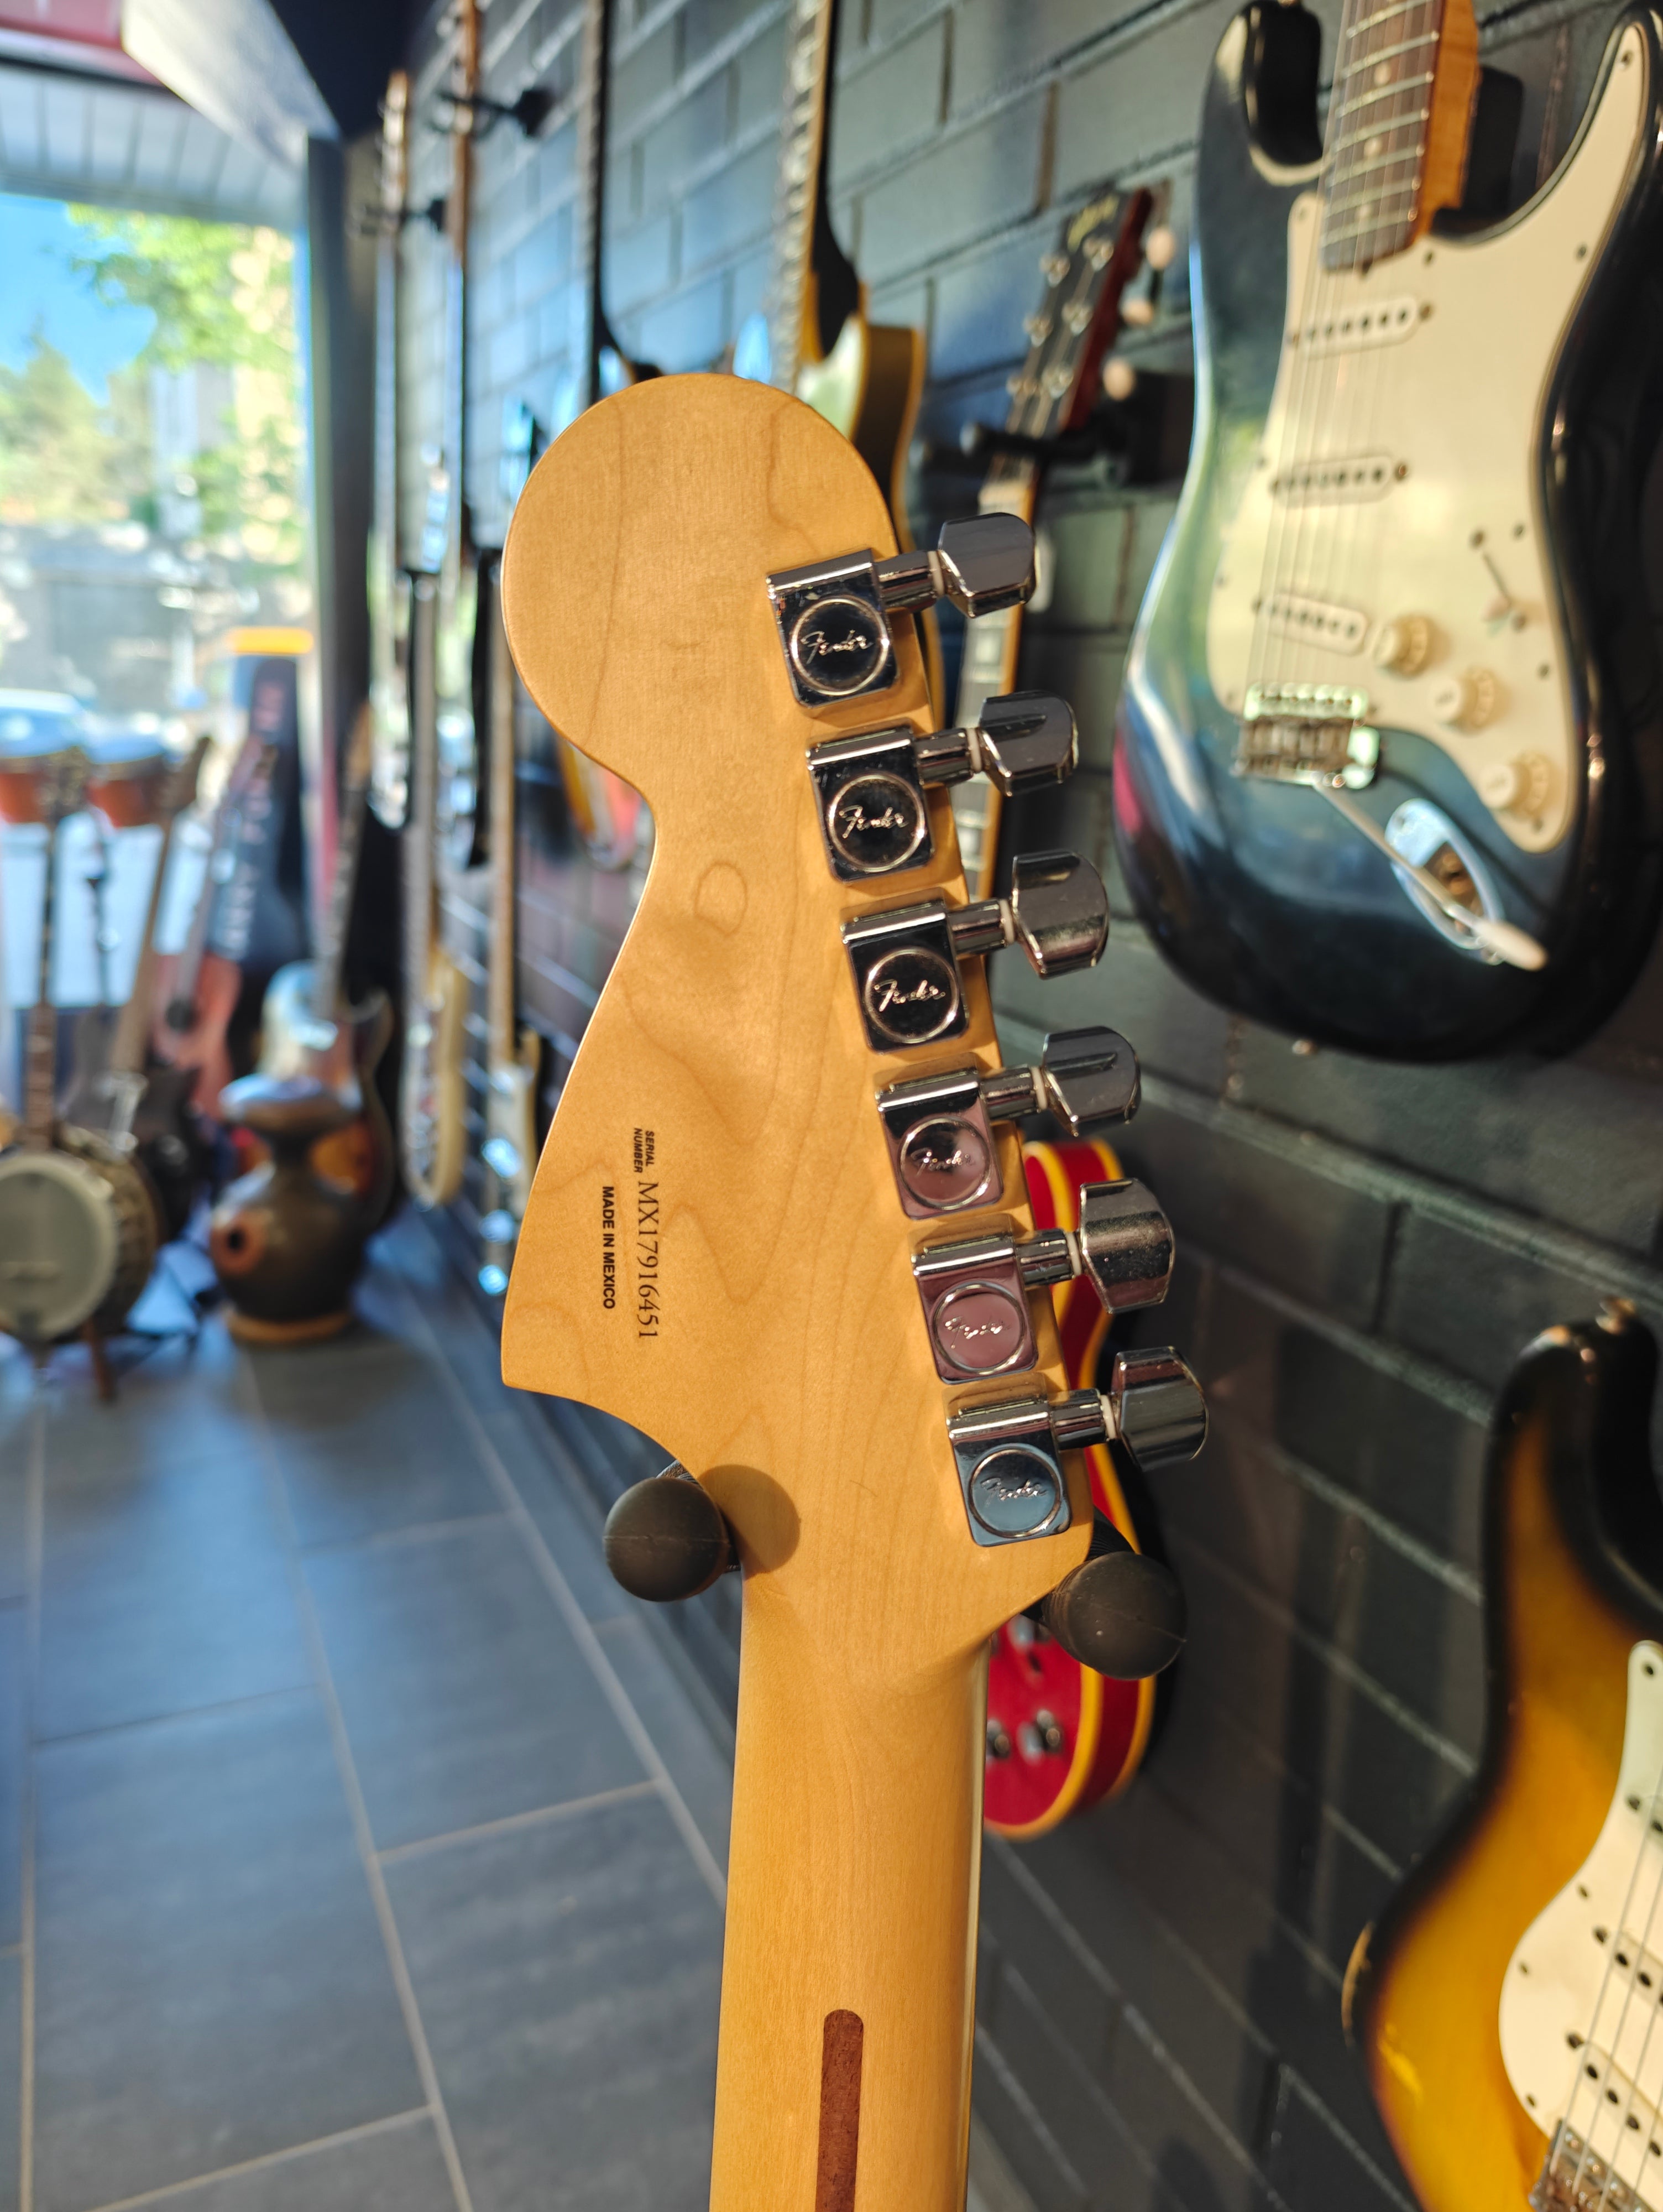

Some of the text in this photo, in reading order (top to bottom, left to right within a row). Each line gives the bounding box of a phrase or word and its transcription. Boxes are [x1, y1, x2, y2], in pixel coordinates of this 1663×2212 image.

[634, 1128, 643, 1173] NUMBER
[645, 1130, 655, 1167] SERIAL
[602, 1186, 616, 1310] MADE IN MEXICO
[637, 1181, 660, 1338] MX17916451
